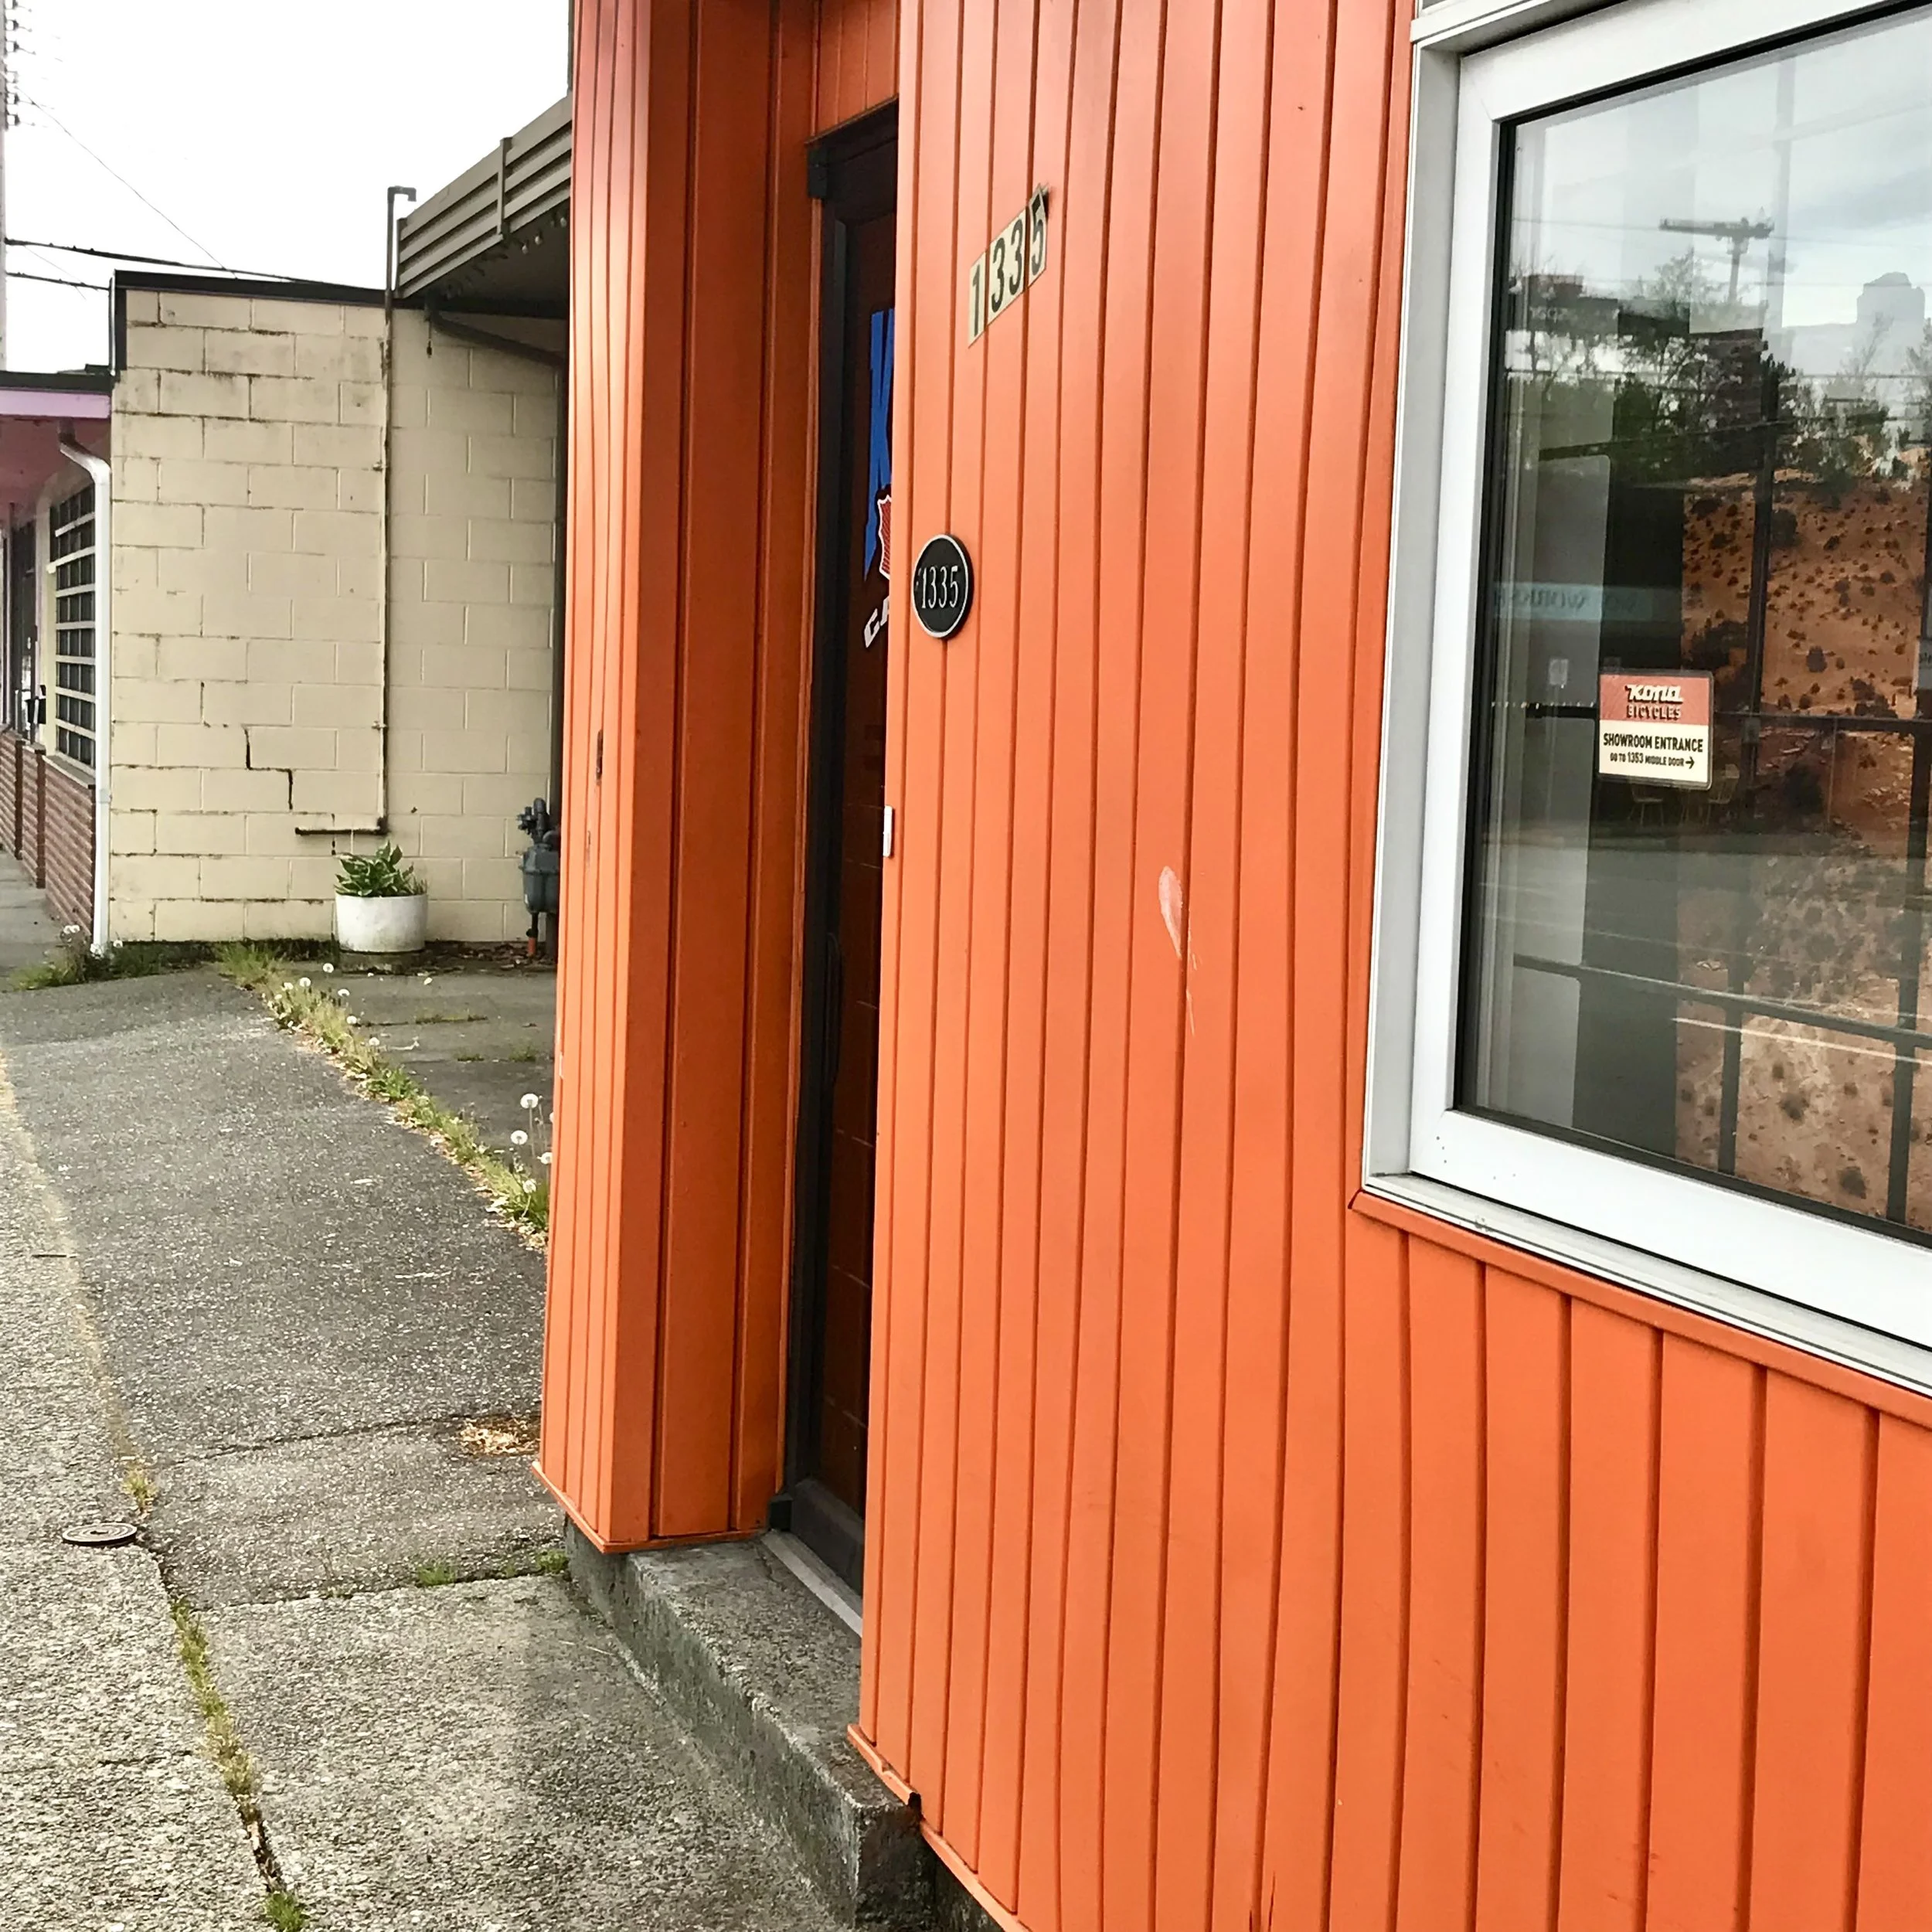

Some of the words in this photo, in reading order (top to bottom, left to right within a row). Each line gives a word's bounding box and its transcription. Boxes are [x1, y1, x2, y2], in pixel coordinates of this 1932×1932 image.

[972, 193, 1043, 337] 1335
[921, 565, 959, 608] 1335
[1624, 684, 1684, 704] Kona
[1627, 705, 1681, 721] BICYCLES
[1603, 733, 1652, 749] SHOWROOM
[1655, 736, 1703, 753] ENTRANCE
[1610, 753, 1617, 762] GO
[1618, 753, 1626, 762] TO
[1628, 751, 1644, 764] 1353
[1645, 755, 1667, 766] MIDDLE
[1668, 757, 1685, 767] DOOR
